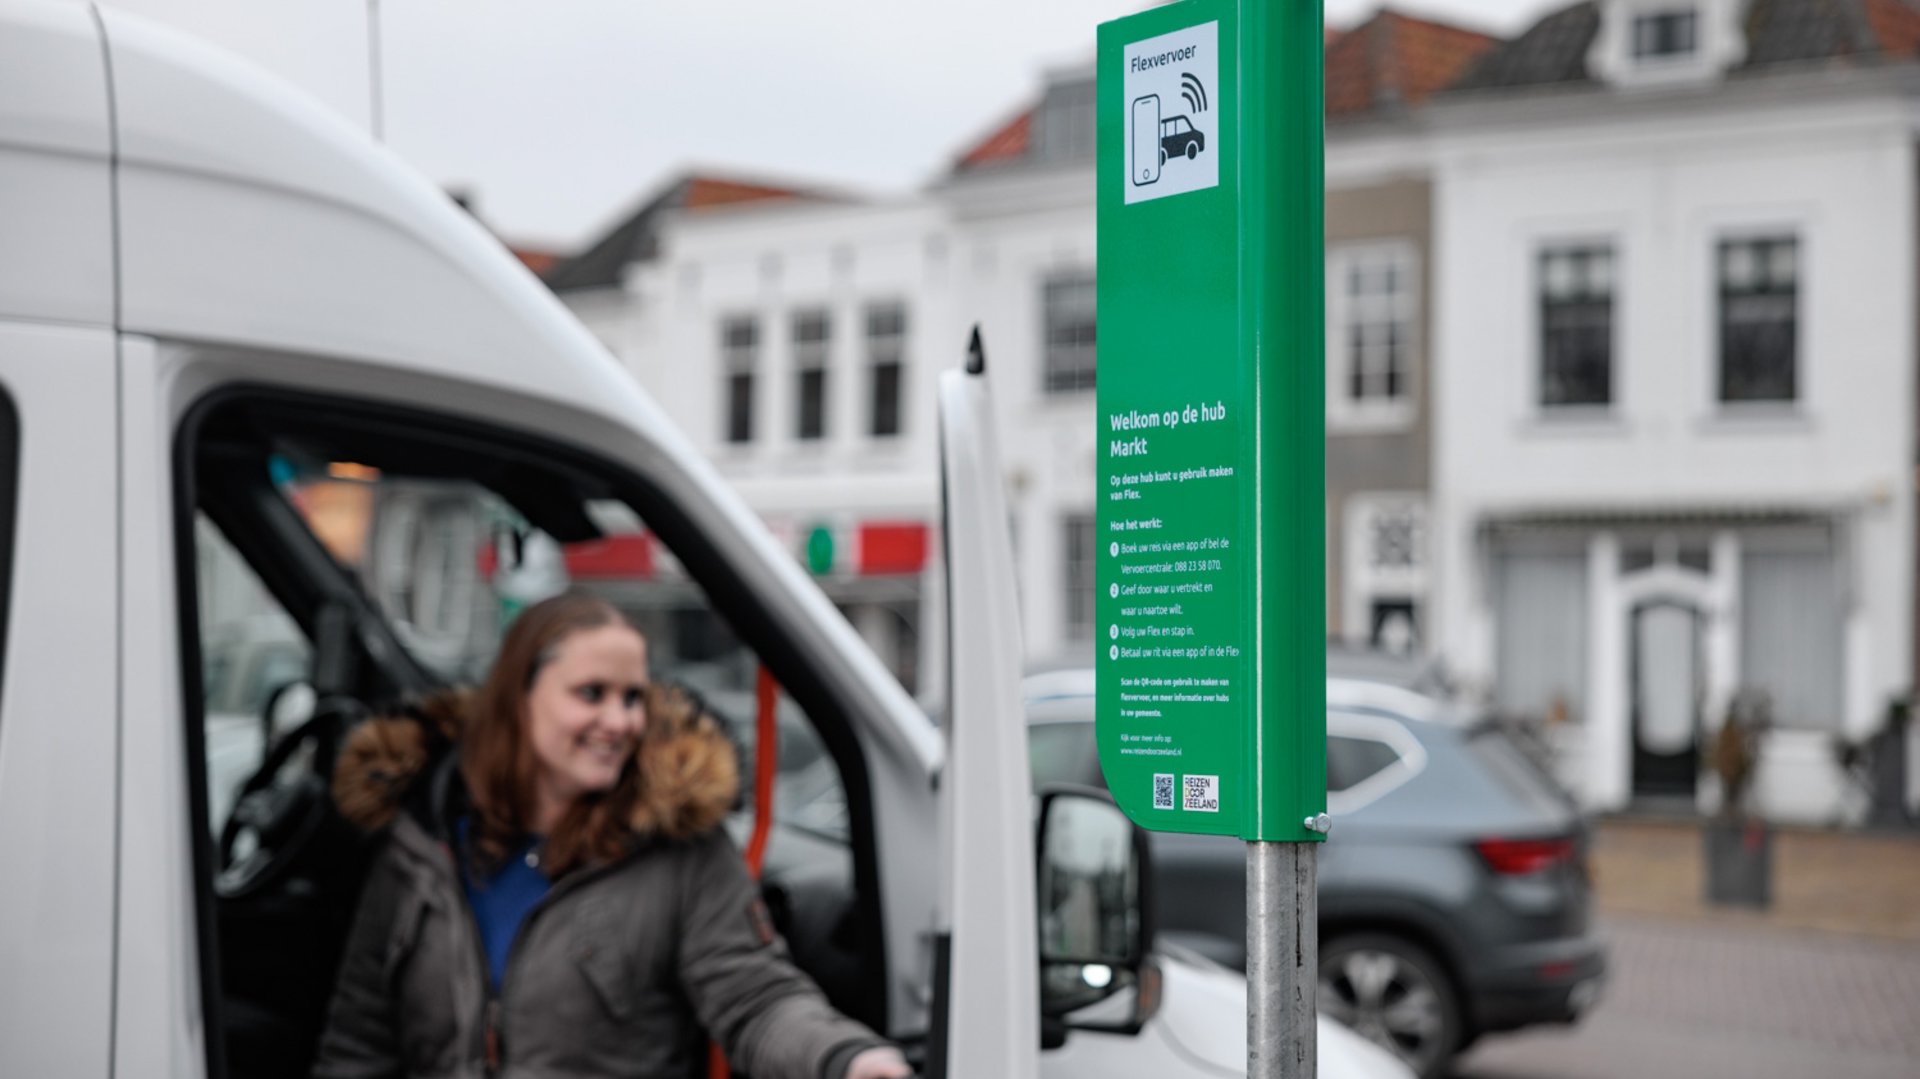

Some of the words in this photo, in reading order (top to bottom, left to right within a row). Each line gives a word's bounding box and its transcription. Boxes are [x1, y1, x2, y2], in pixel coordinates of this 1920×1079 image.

[1130, 45, 1197, 73] Flexvervoer
[1110, 410, 1160, 431] Welkom
[1162, 411, 1179, 429] op
[1182, 404, 1198, 424] de
[1201, 400, 1226, 422] hub
[1110, 436, 1148, 457] Markt
[1110, 475, 1121, 487] Op
[1122, 474, 1139, 485] deze
[1140, 472, 1154, 483] hub
[1155, 470, 1172, 482] kunt
[1172, 472, 1179, 480] u
[1179, 466, 1208, 482] gebruik
[1208, 465, 1234, 477] maken
[1110, 491, 1123, 501] van
[1124, 488, 1141, 500] Flex.
[1110, 521, 1125, 532] Hoe
[1126, 519, 1138, 530] het
[1139, 517, 1163, 529] werkt:
[1121, 542, 1137, 554] Boek
[1138, 544, 1148, 553] uw
[1149, 542, 1161, 552] reis
[1161, 541, 1172, 551] via
[1172, 542, 1185, 551] een
[1186, 541, 1198, 552] app
[1199, 538, 1207, 549] of
[1207, 538, 1219, 549] bel
[1220, 537, 1229, 549] de
[1174, 561, 1188, 572] 088
[1188, 560, 1197, 572] 23
[1197, 560, 1207, 571] 58
[1121, 584, 1137, 595] Geef
[1137, 584, 1152, 595] door
[1153, 585, 1169, 594] waar
[1176, 582, 1203, 593] vertrekt
[1204, 584, 1213, 592] en
[1121, 607, 1137, 616] waar
[1143, 605, 1168, 615] naartoe
[1121, 626, 1136, 639] Volg
[1136, 628, 1147, 637] uw
[1147, 625, 1161, 636] Flex
[1162, 627, 1171, 636] en
[1171, 626, 1186, 637] stap
[1121, 647, 1141, 658] Betaal
[1142, 649, 1153, 657] uw
[1162, 647, 1172, 656] via
[1172, 648, 1185, 657] een
[1186, 648, 1198, 659] app
[1199, 645, 1207, 656] of
[1208, 646, 1215, 656] in
[1216, 645, 1225, 656] de
[1184, 798, 1218, 810] ZEELAND
